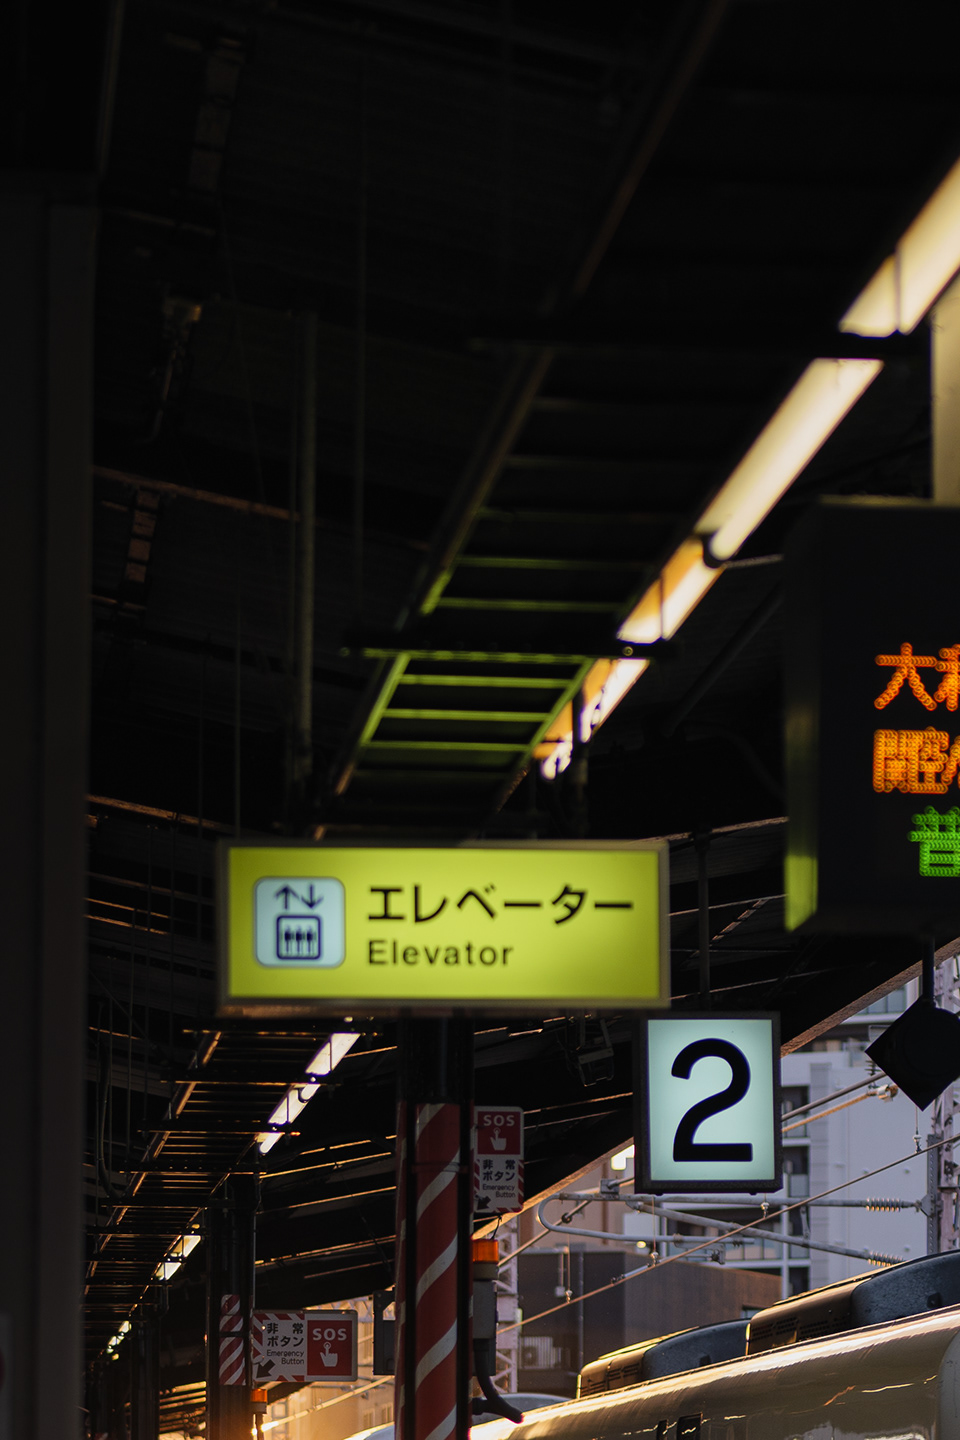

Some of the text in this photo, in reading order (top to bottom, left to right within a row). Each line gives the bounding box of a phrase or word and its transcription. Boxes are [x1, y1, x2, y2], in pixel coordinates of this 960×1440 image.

[367, 883, 634, 925] エレベーター
[367, 940, 514, 966] Elevator
[671, 1037, 754, 1163] 2
[483, 1114, 515, 1127] SOS
[483, 1171, 515, 1181] ボタン
[482, 1184, 515, 1193] Emergency
[496, 1190, 516, 1198] Button
[312, 1328, 347, 1341] SOS
[267, 1335, 304, 1347] ボタン
[266, 1349, 304, 1357] Emergency
